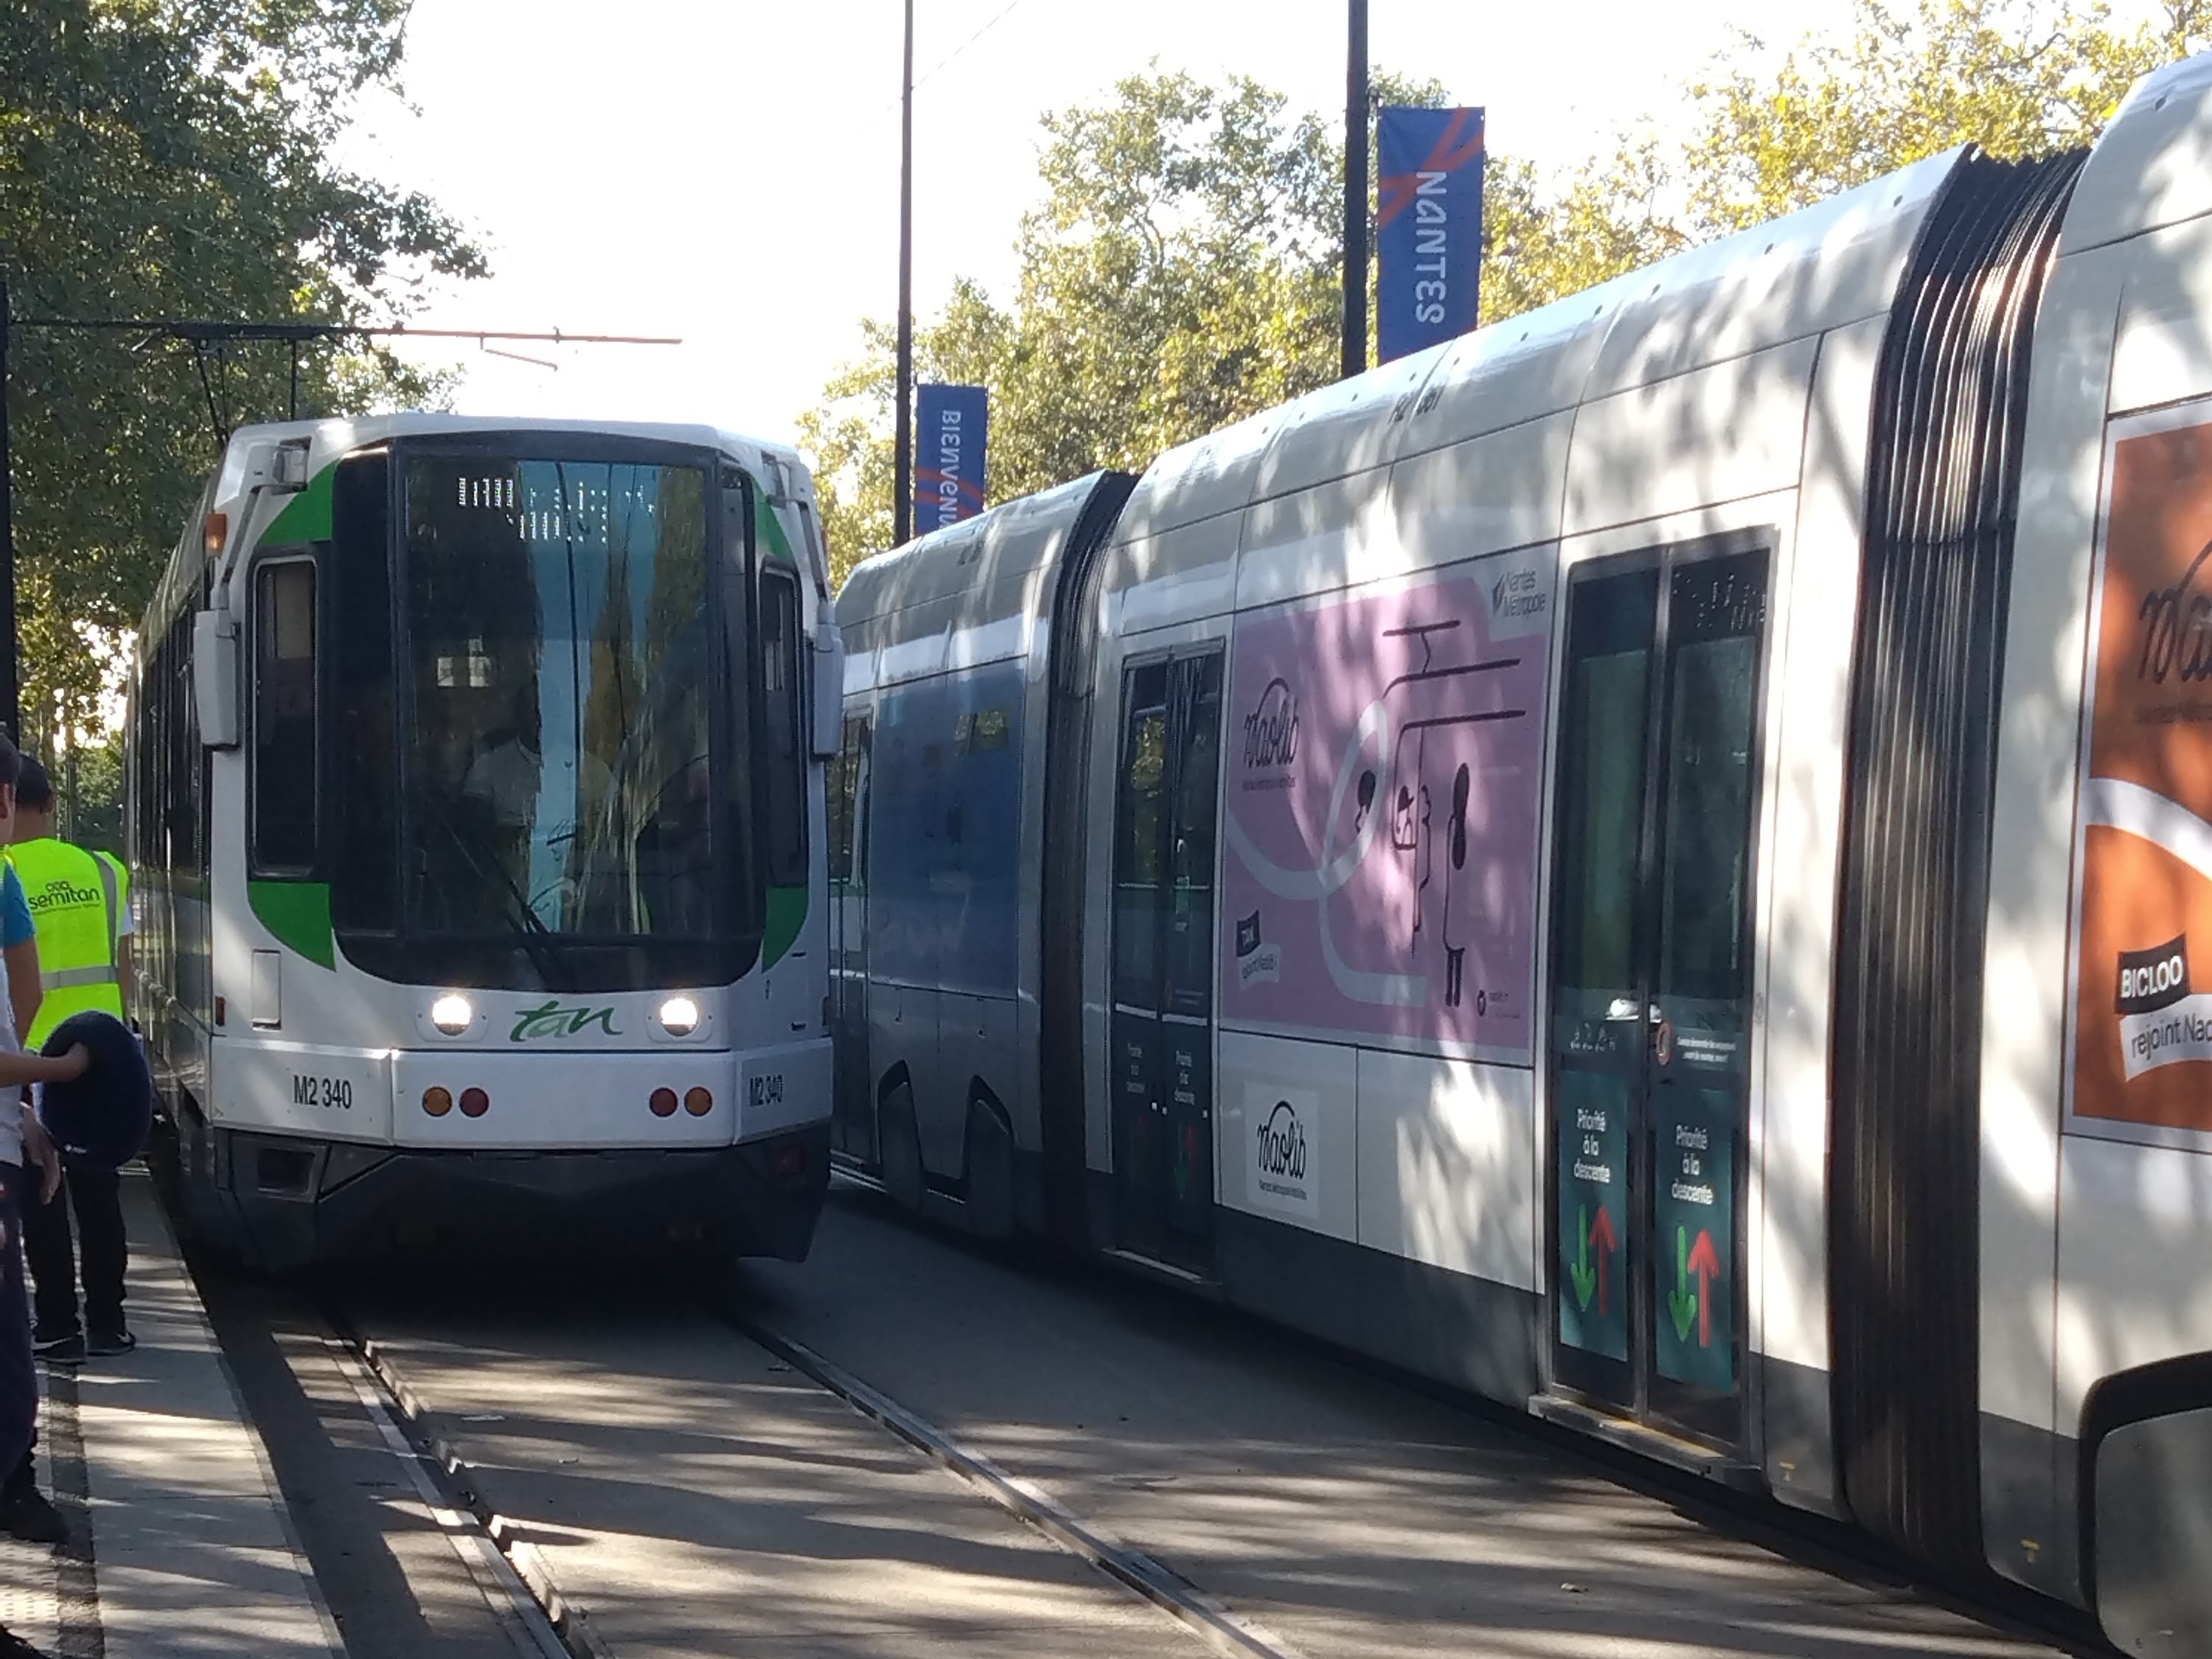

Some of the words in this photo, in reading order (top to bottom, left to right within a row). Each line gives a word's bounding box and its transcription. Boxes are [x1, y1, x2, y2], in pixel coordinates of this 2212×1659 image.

[1415, 170, 1447, 324] NANTES
[27, 887, 100, 911] semitan
[2120, 955, 2184, 999] BICLOO
[509, 1000, 624, 1042] tan
[2131, 1017, 2182, 1061] rejoint
[293, 1074, 319, 1107] M2
[321, 1078, 352, 1109] 340
[749, 1077, 764, 1107] M2
[765, 1074, 783, 1104] 340
